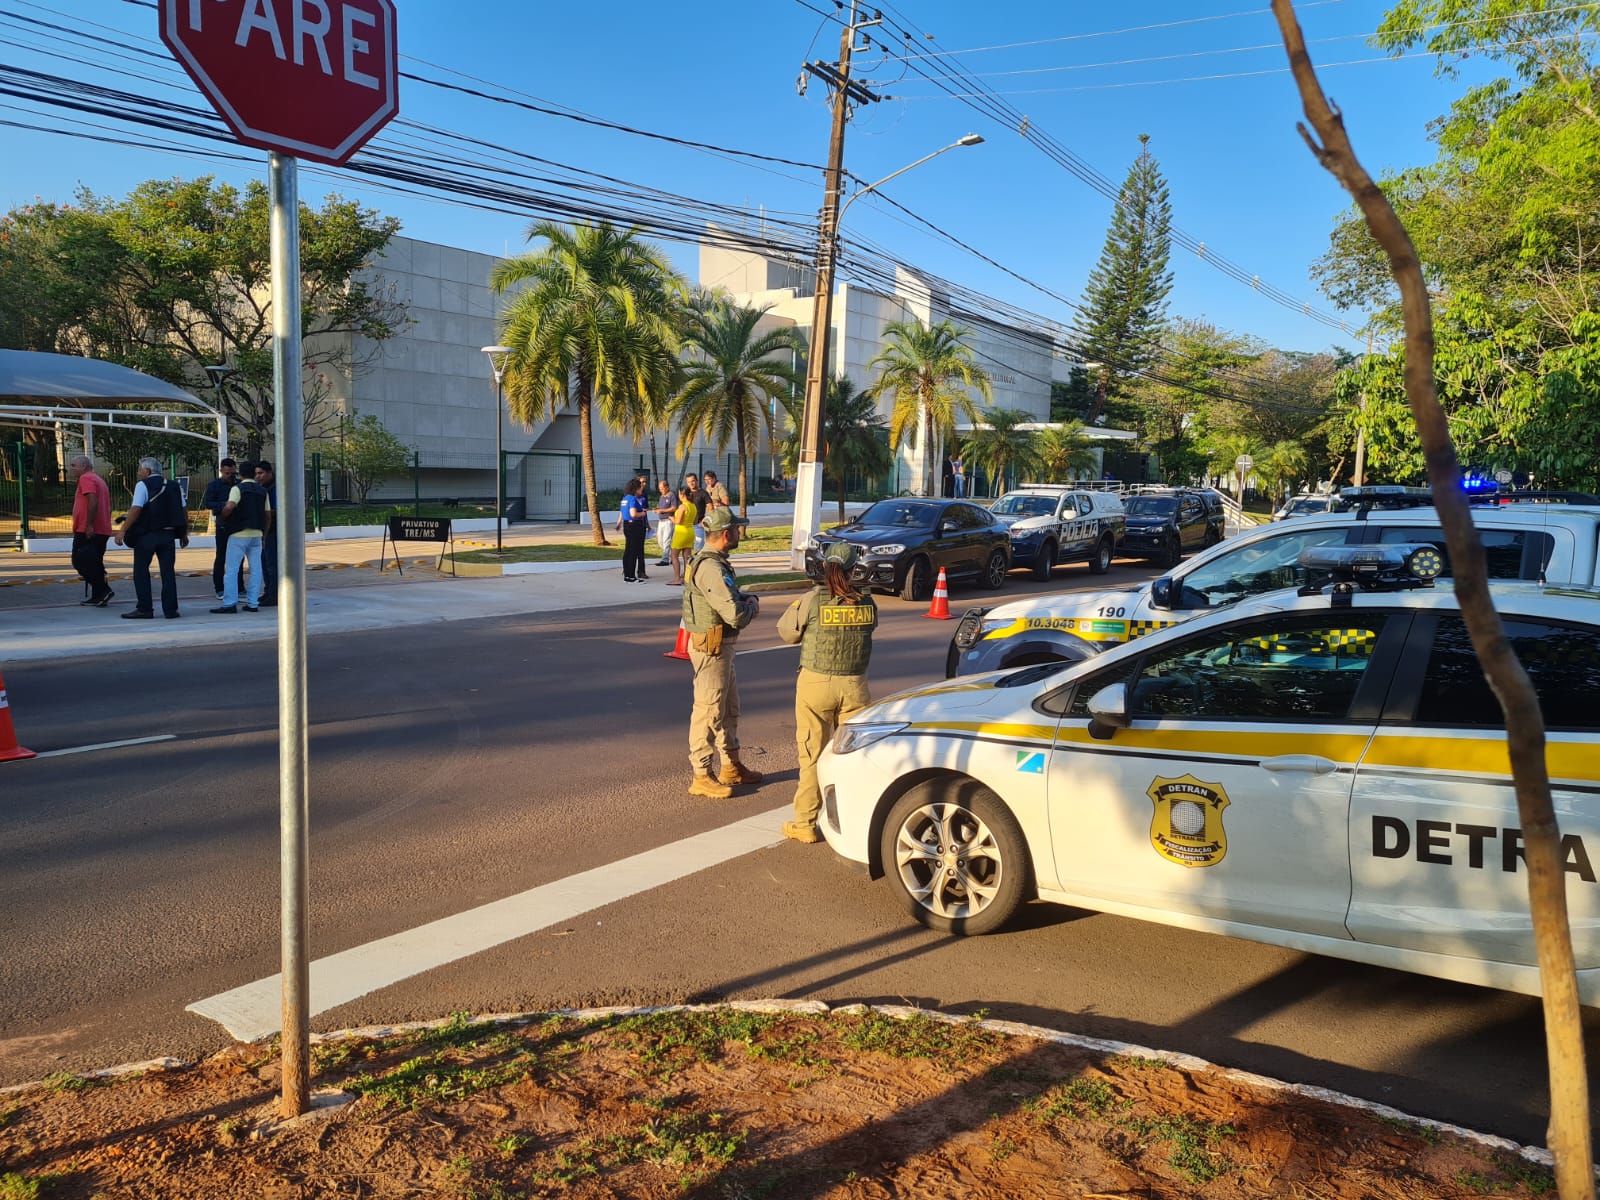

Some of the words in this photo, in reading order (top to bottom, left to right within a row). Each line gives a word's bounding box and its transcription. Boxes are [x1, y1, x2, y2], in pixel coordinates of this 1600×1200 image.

[401, 520, 440, 528] PRIVATIVO
[404, 529, 436, 537] TRE/MS
[823, 607, 872, 623] DETRAN
[1097, 606, 1125, 618] 190
[1027, 617, 1075, 629] 10.3048
[1168, 784, 1208, 797] DETRAN
